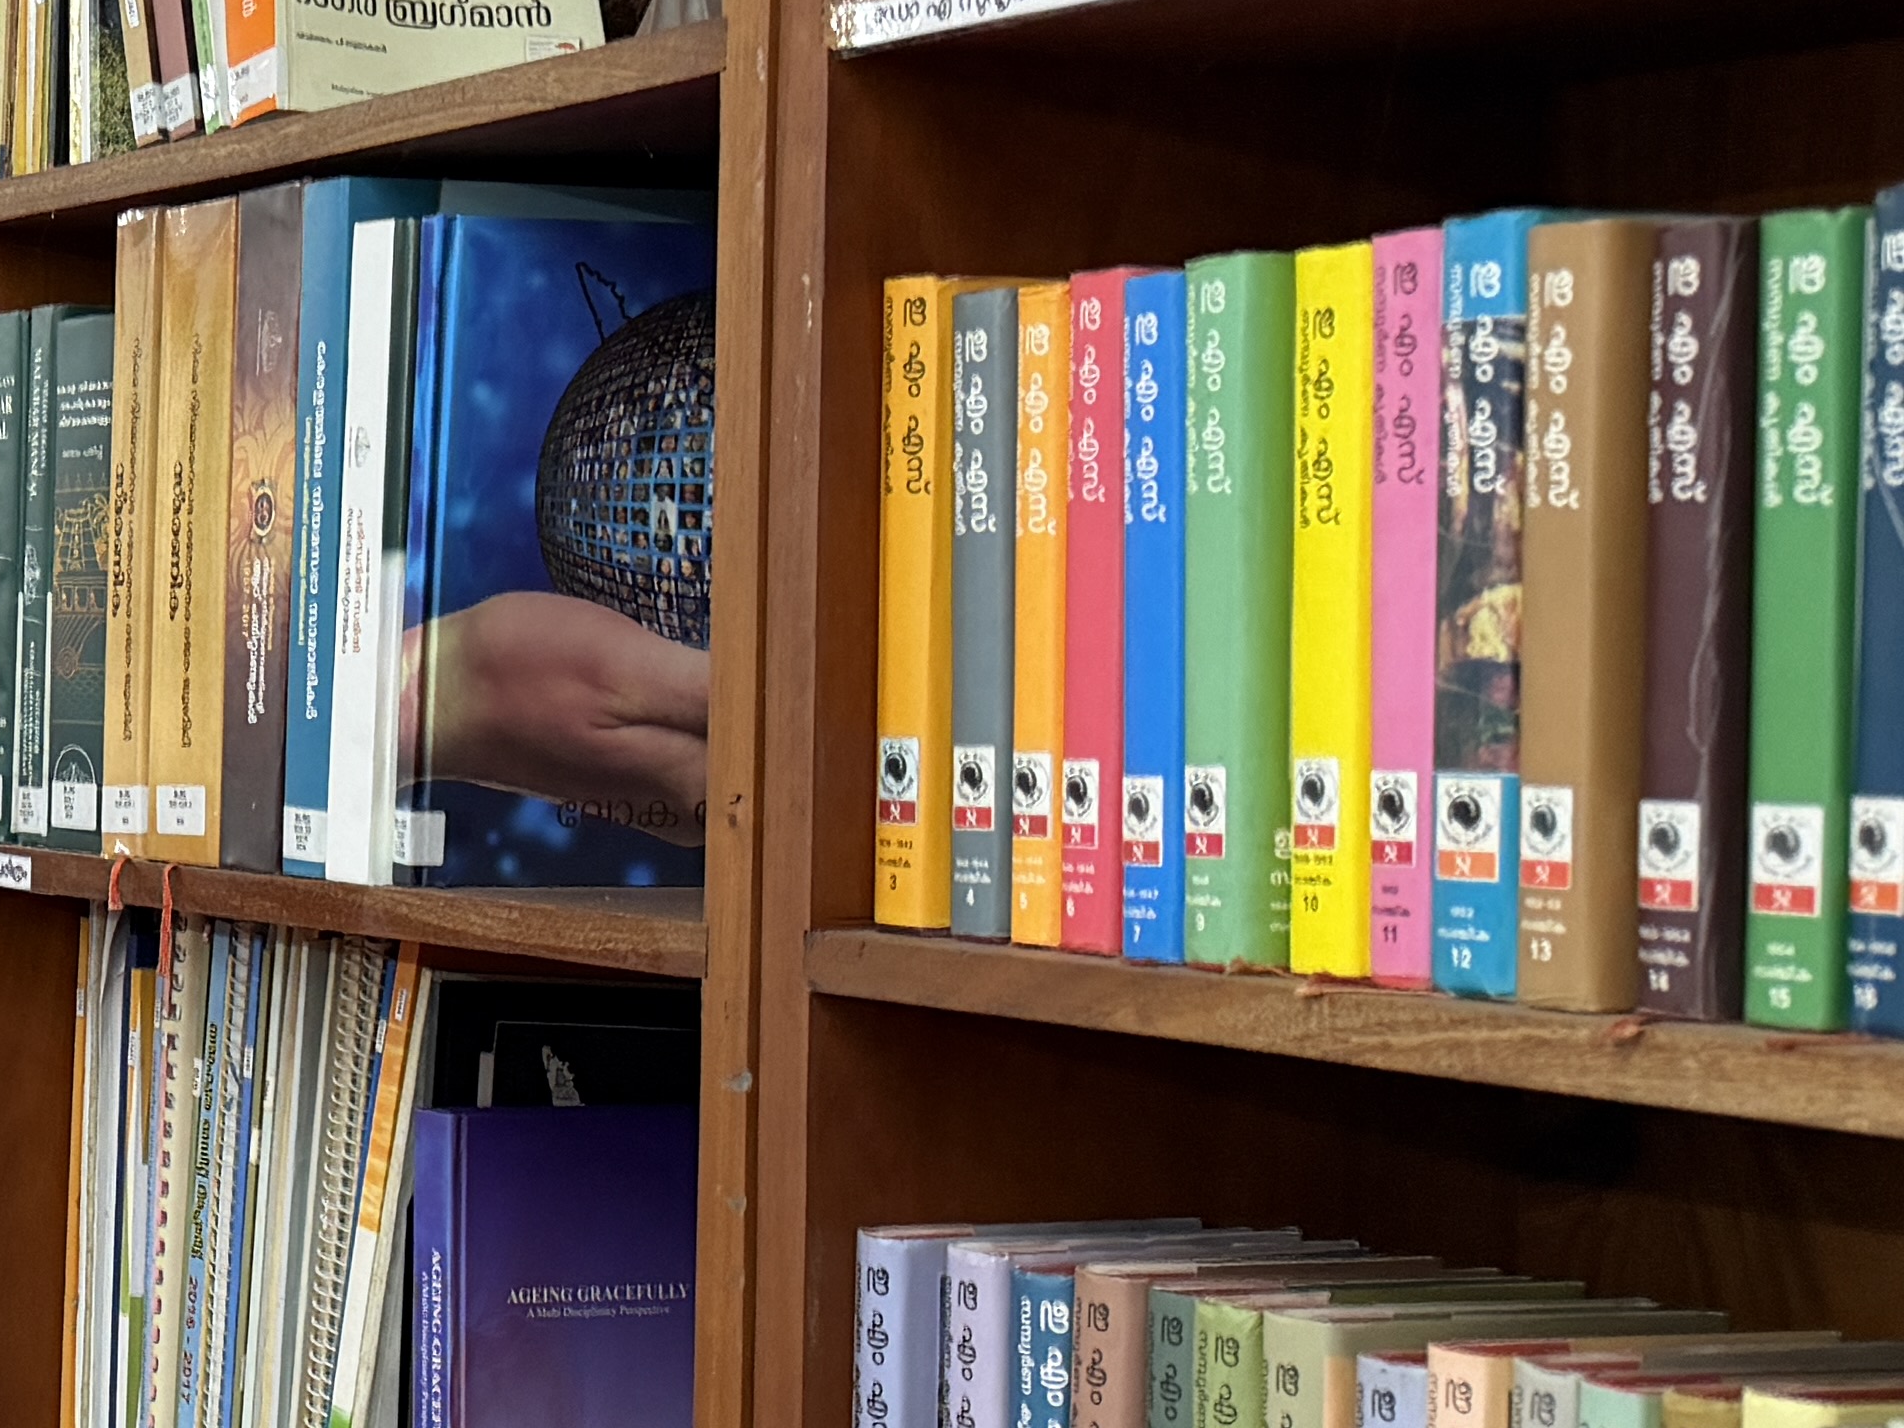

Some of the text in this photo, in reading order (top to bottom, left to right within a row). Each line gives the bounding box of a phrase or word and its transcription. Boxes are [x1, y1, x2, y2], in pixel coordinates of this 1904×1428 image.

[900, 295, 928, 398] ഇ എം
[1198, 277, 1226, 394] ഇ എം
[1469, 261, 1501, 383] ഇ എം
[1788, 253, 1826, 386] ഇ എം
[1077, 293, 1103, 406] ഇ എം
[557, 800, 678, 828] ലോക
[888, 873, 898, 893] 3
[965, 889, 976, 908] 4
[1302, 893, 1319, 914] 10
[1382, 923, 1400, 943] 11
[1449, 946, 1473, 969] 12
[1530, 937, 1554, 961] 13
[431, 1248, 441, 1333] AGEING
[507, 1283, 690, 1304] AGEING GRACEFULLY
[527, 1307, 535, 1318] A
[866, 1264, 891, 1367] ഇ എം
[1040, 1300, 1069, 1407] ഇ എം
[1086, 1299, 1111, 1408] ഇ എം
